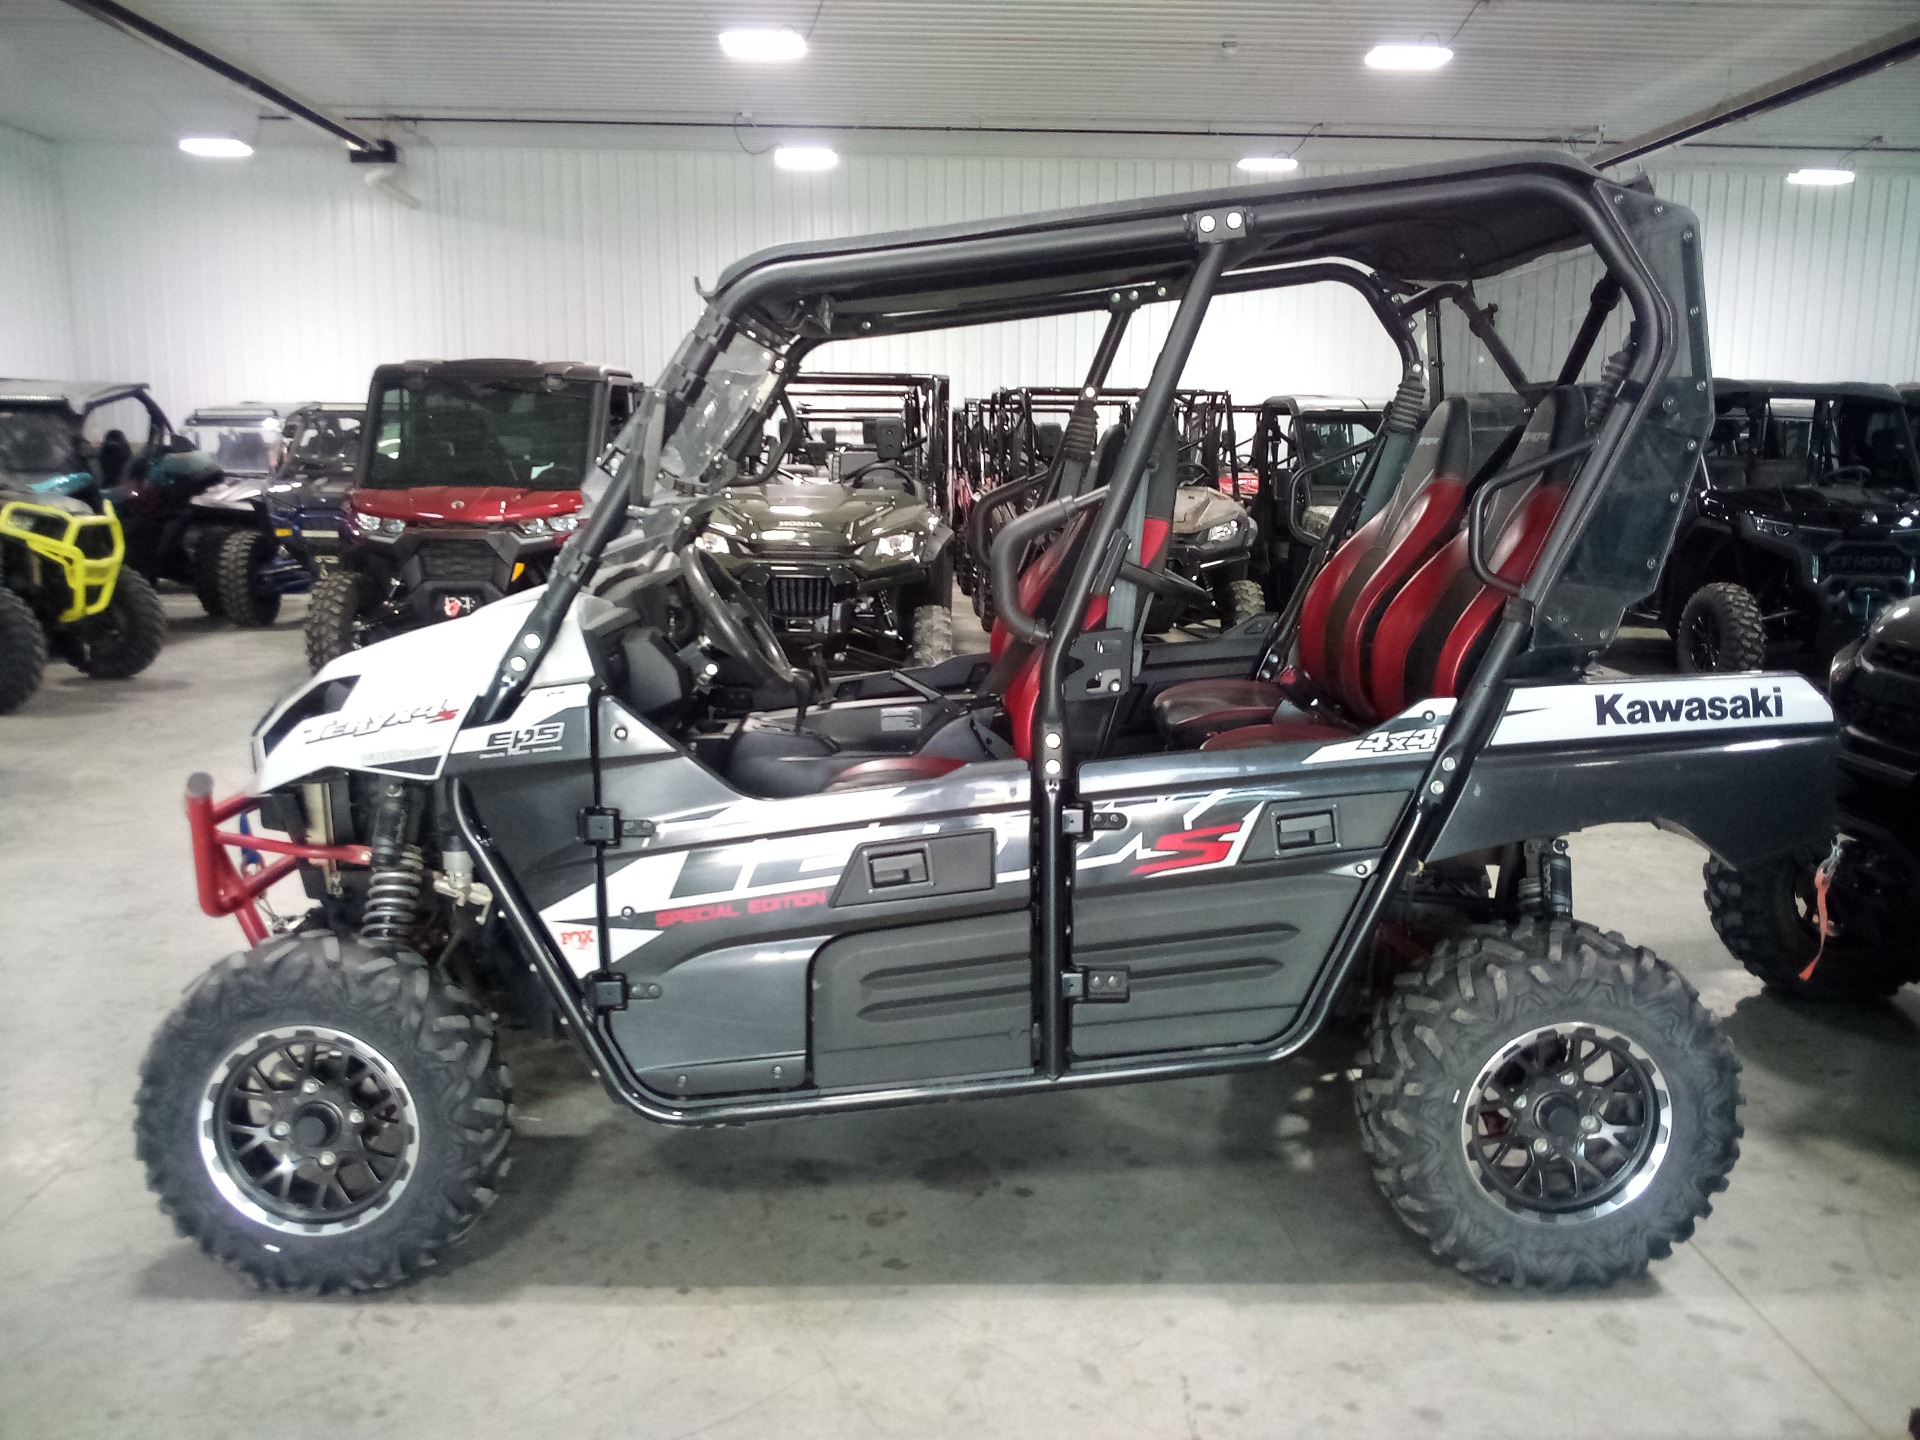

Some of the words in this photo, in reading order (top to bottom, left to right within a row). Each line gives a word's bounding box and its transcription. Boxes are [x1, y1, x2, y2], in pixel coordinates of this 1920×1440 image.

[778, 520, 823, 528] HONDA
[1594, 686, 1783, 726] Kawasaki
[1356, 728, 1437, 752] 4x4
[655, 903, 741, 928] SPECIAL
[747, 889, 828, 914] EDITION
[561, 930, 594, 947] FOX
